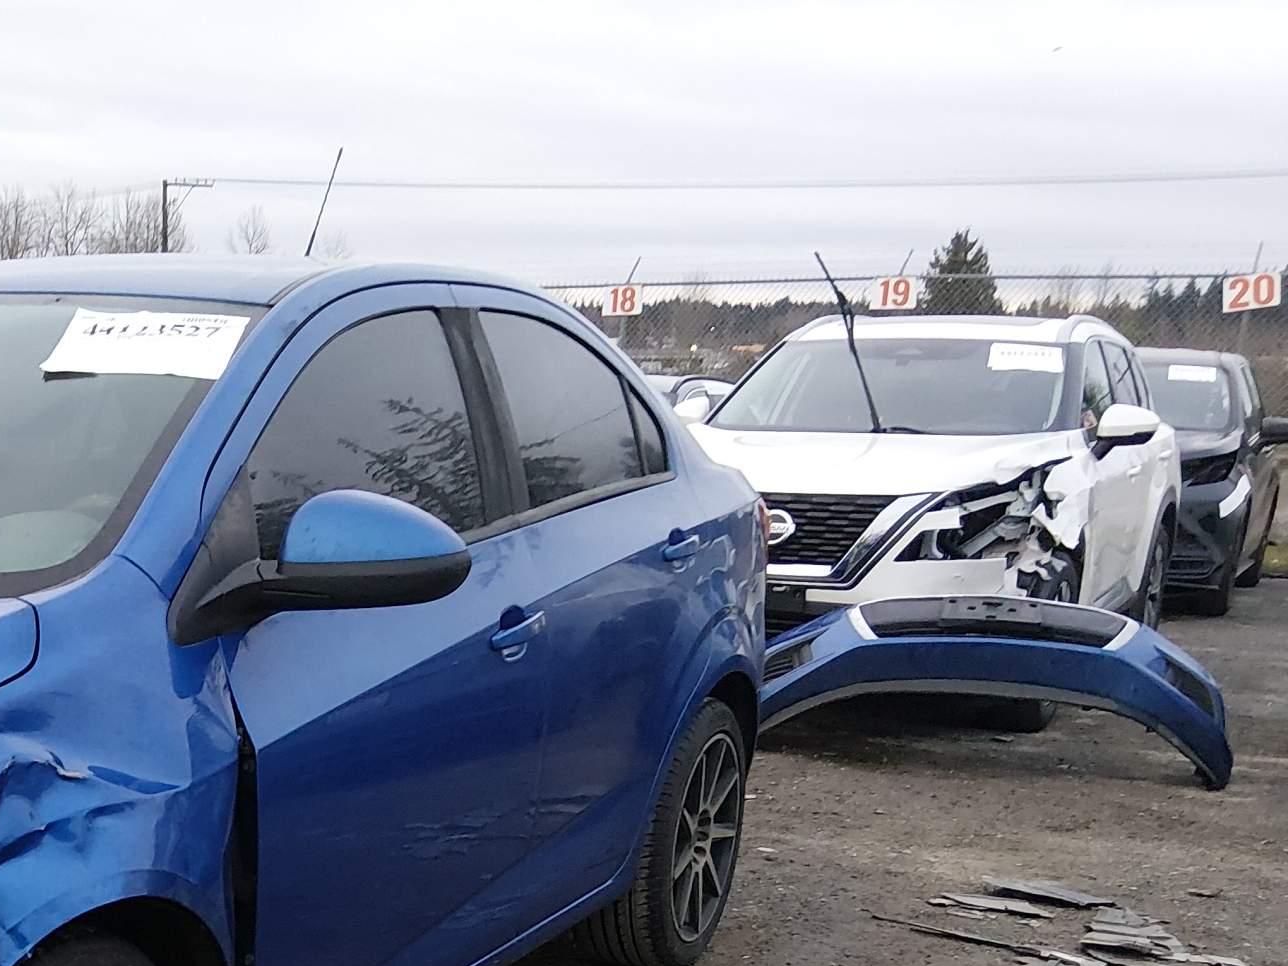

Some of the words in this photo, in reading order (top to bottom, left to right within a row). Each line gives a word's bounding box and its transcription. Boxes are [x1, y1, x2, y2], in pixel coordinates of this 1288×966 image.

[610, 287, 636, 313] 18
[880, 279, 911, 306] 19
[1228, 273, 1275, 309] 20
